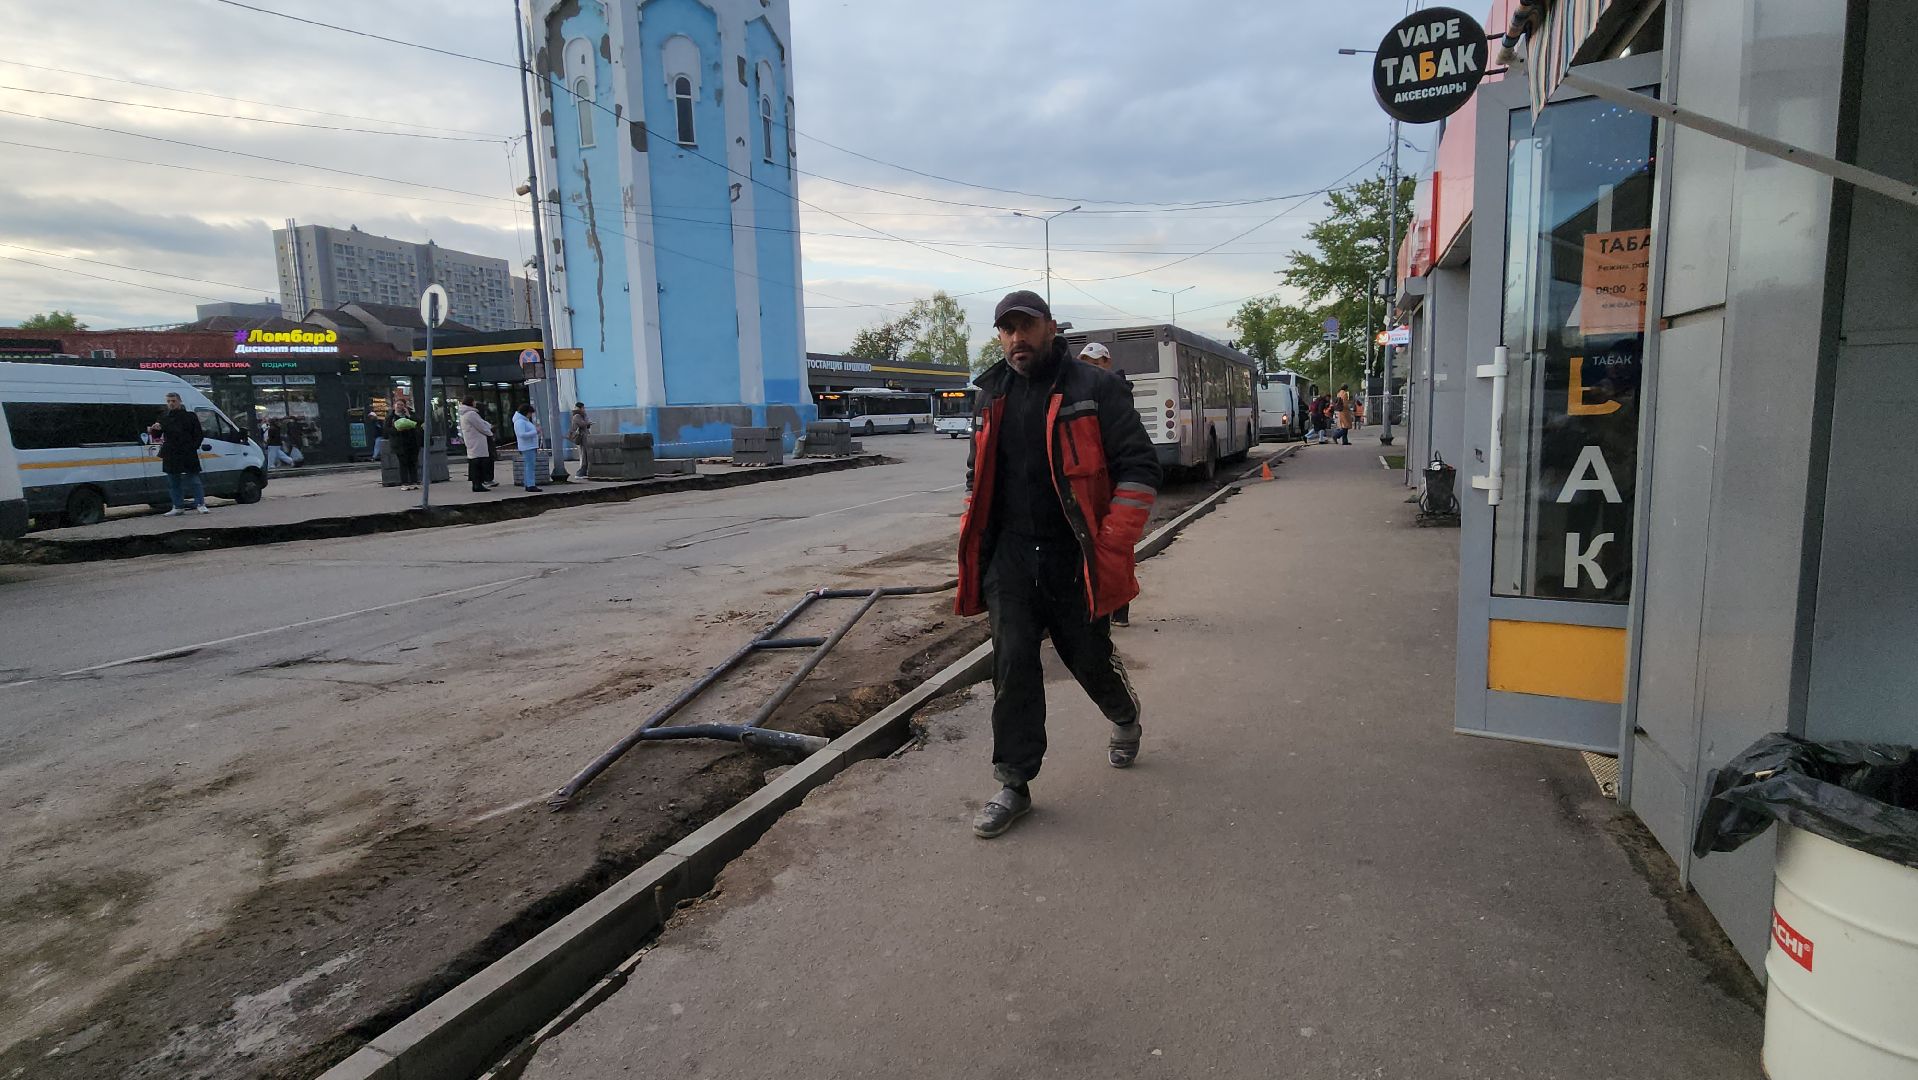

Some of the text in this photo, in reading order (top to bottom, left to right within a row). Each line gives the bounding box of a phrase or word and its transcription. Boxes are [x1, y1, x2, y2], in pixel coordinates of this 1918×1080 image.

[1397, 18, 1460, 48] VAPE
[1381, 43, 1478, 86] ТАБАК
[1394, 82, 1467, 103] АКСЕССУАРЫ
[290, 345, 338, 353] магазин
[1593, 355, 1632, 365] ТАБАК
